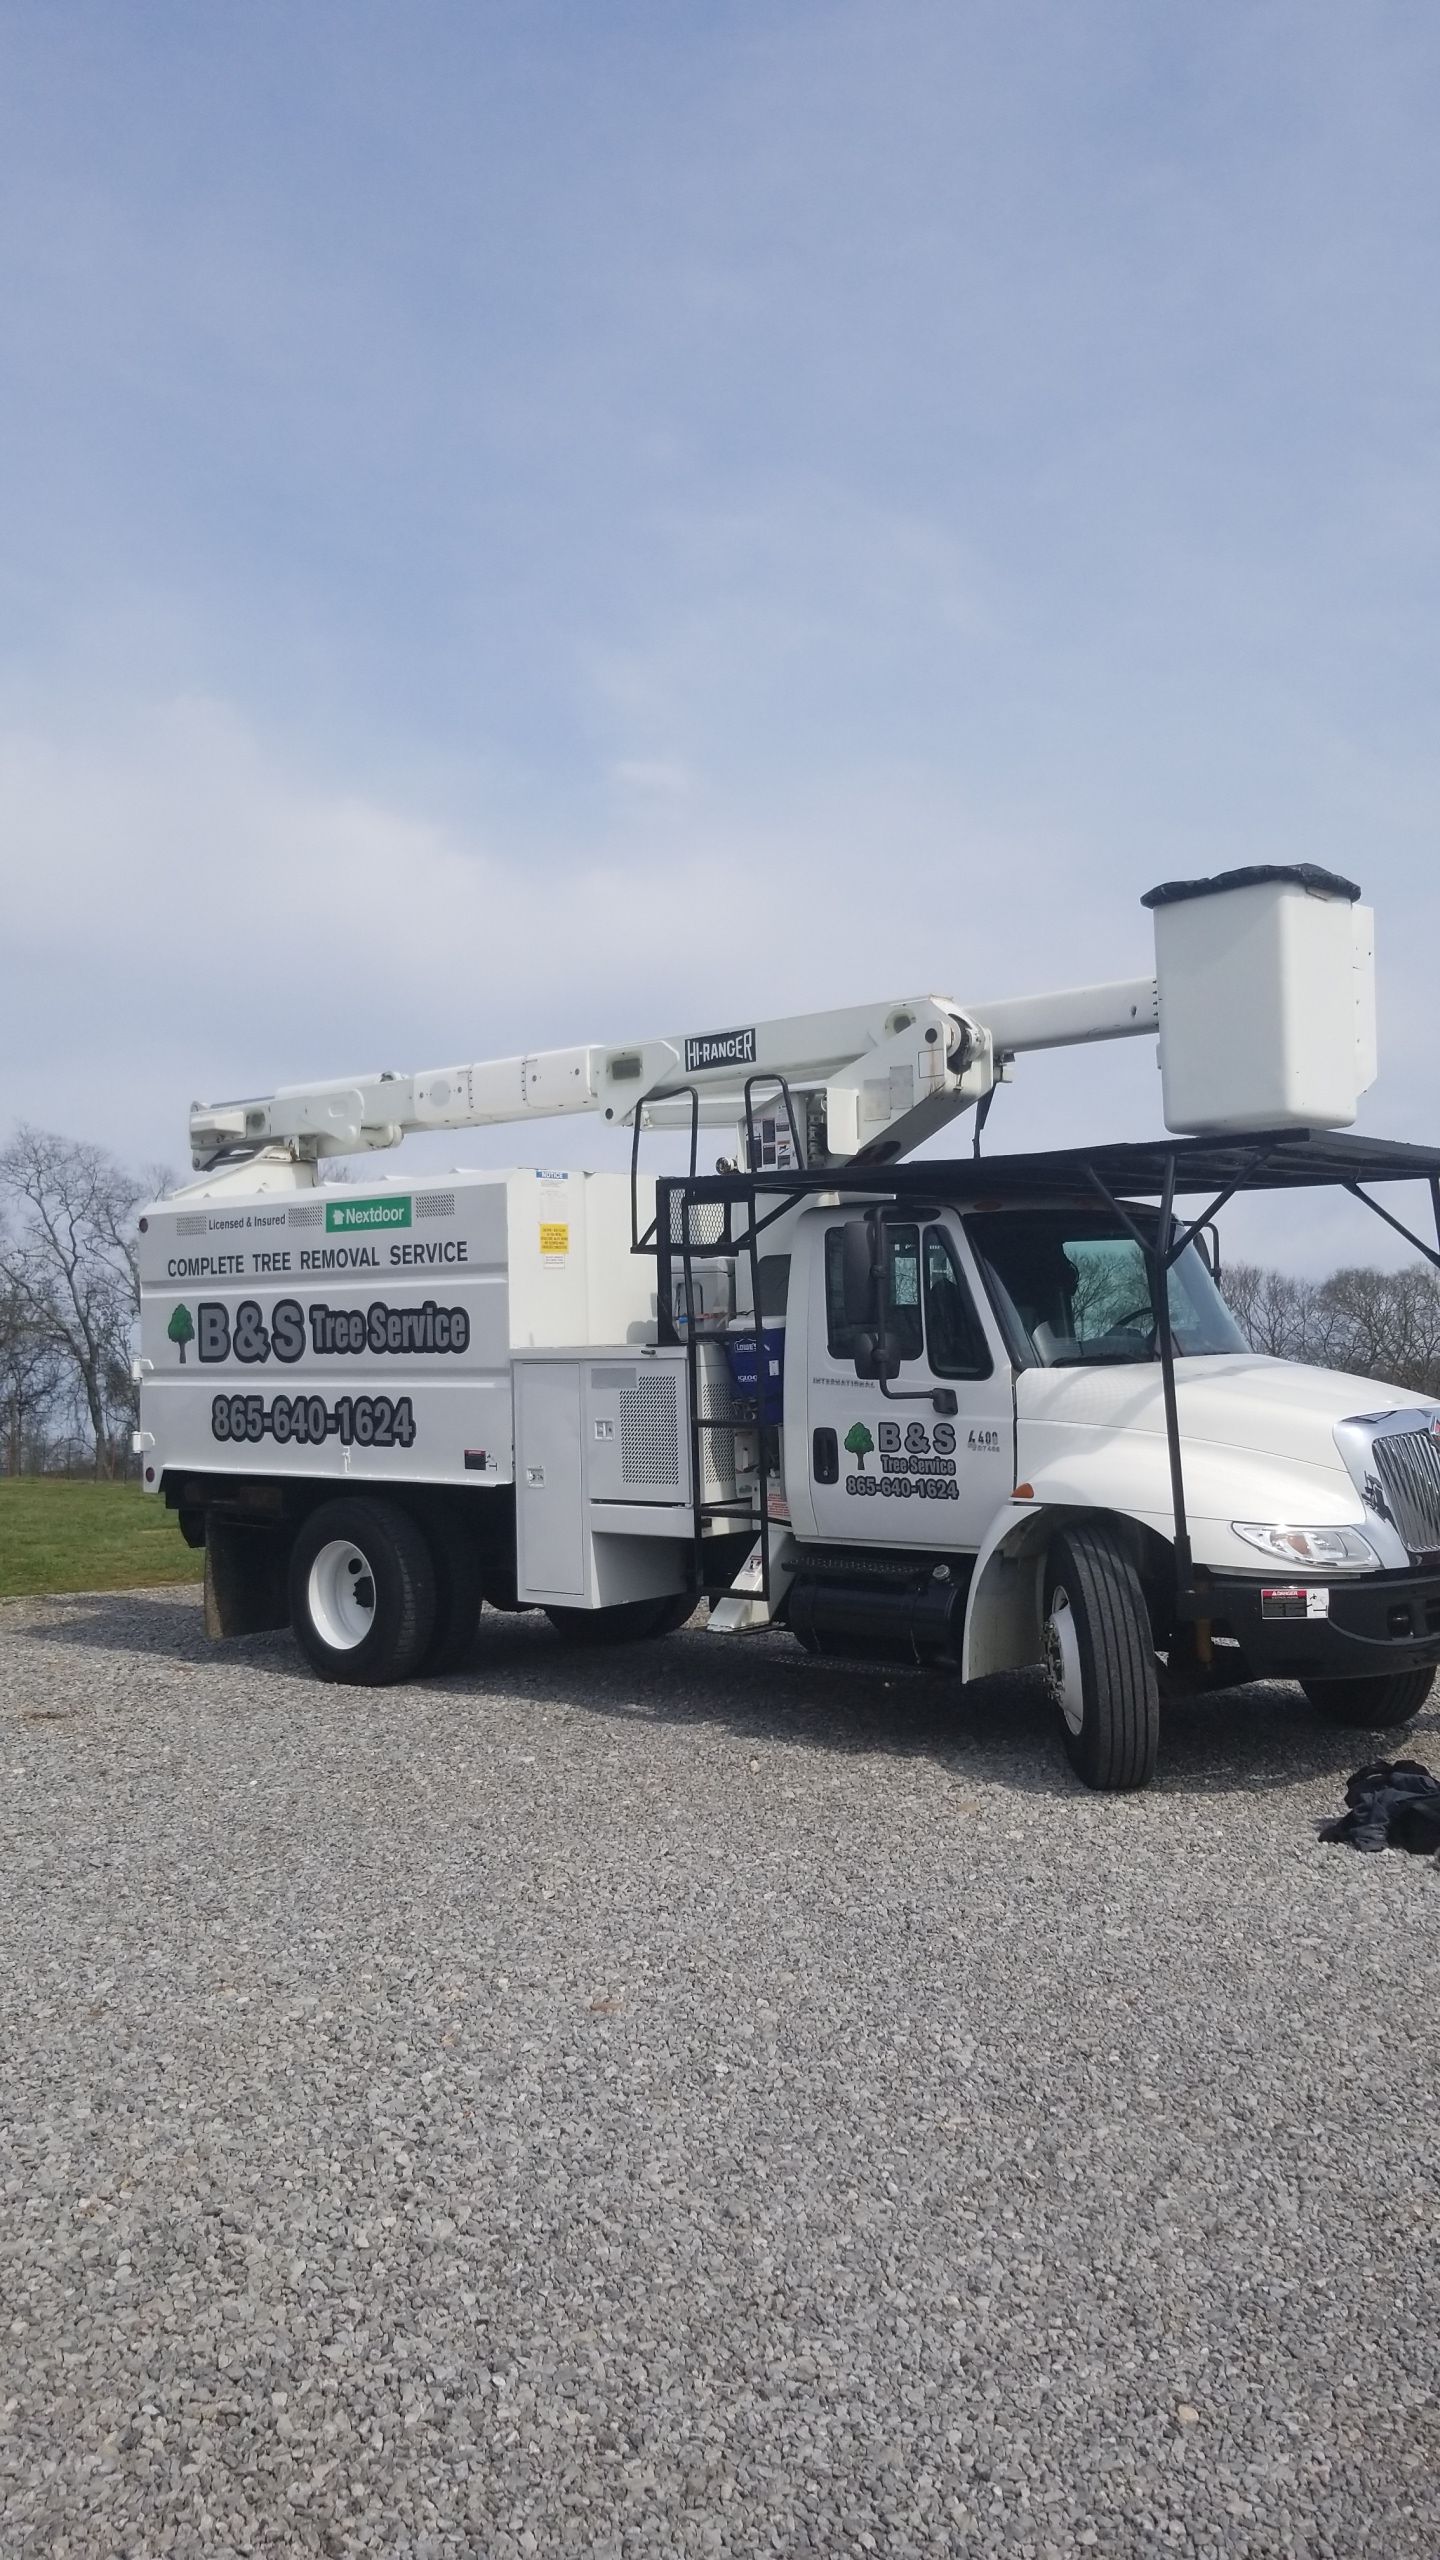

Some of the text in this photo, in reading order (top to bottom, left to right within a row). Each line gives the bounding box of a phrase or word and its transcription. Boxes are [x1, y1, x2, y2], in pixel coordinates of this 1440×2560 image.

[687, 1030, 752, 1071] HI-RANGER
[541, 1170, 564, 1179] NOTICE
[208, 1213, 286, 1231] Licensed & Insured
[346, 1206, 404, 1224] Nextdoor
[167, 1240, 468, 1277] COMPLETE TREE REMOVAL SERVICE
[309, 1304, 366, 1354] Tree
[367, 1300, 470, 1354] Service
[813, 1377, 876, 1389] INTERNATIONAL
[212, 1394, 416, 1448] 865-640-1624
[880, 1454, 956, 1475] Tree Service
[846, 1475, 959, 1500] 865-640-1624
